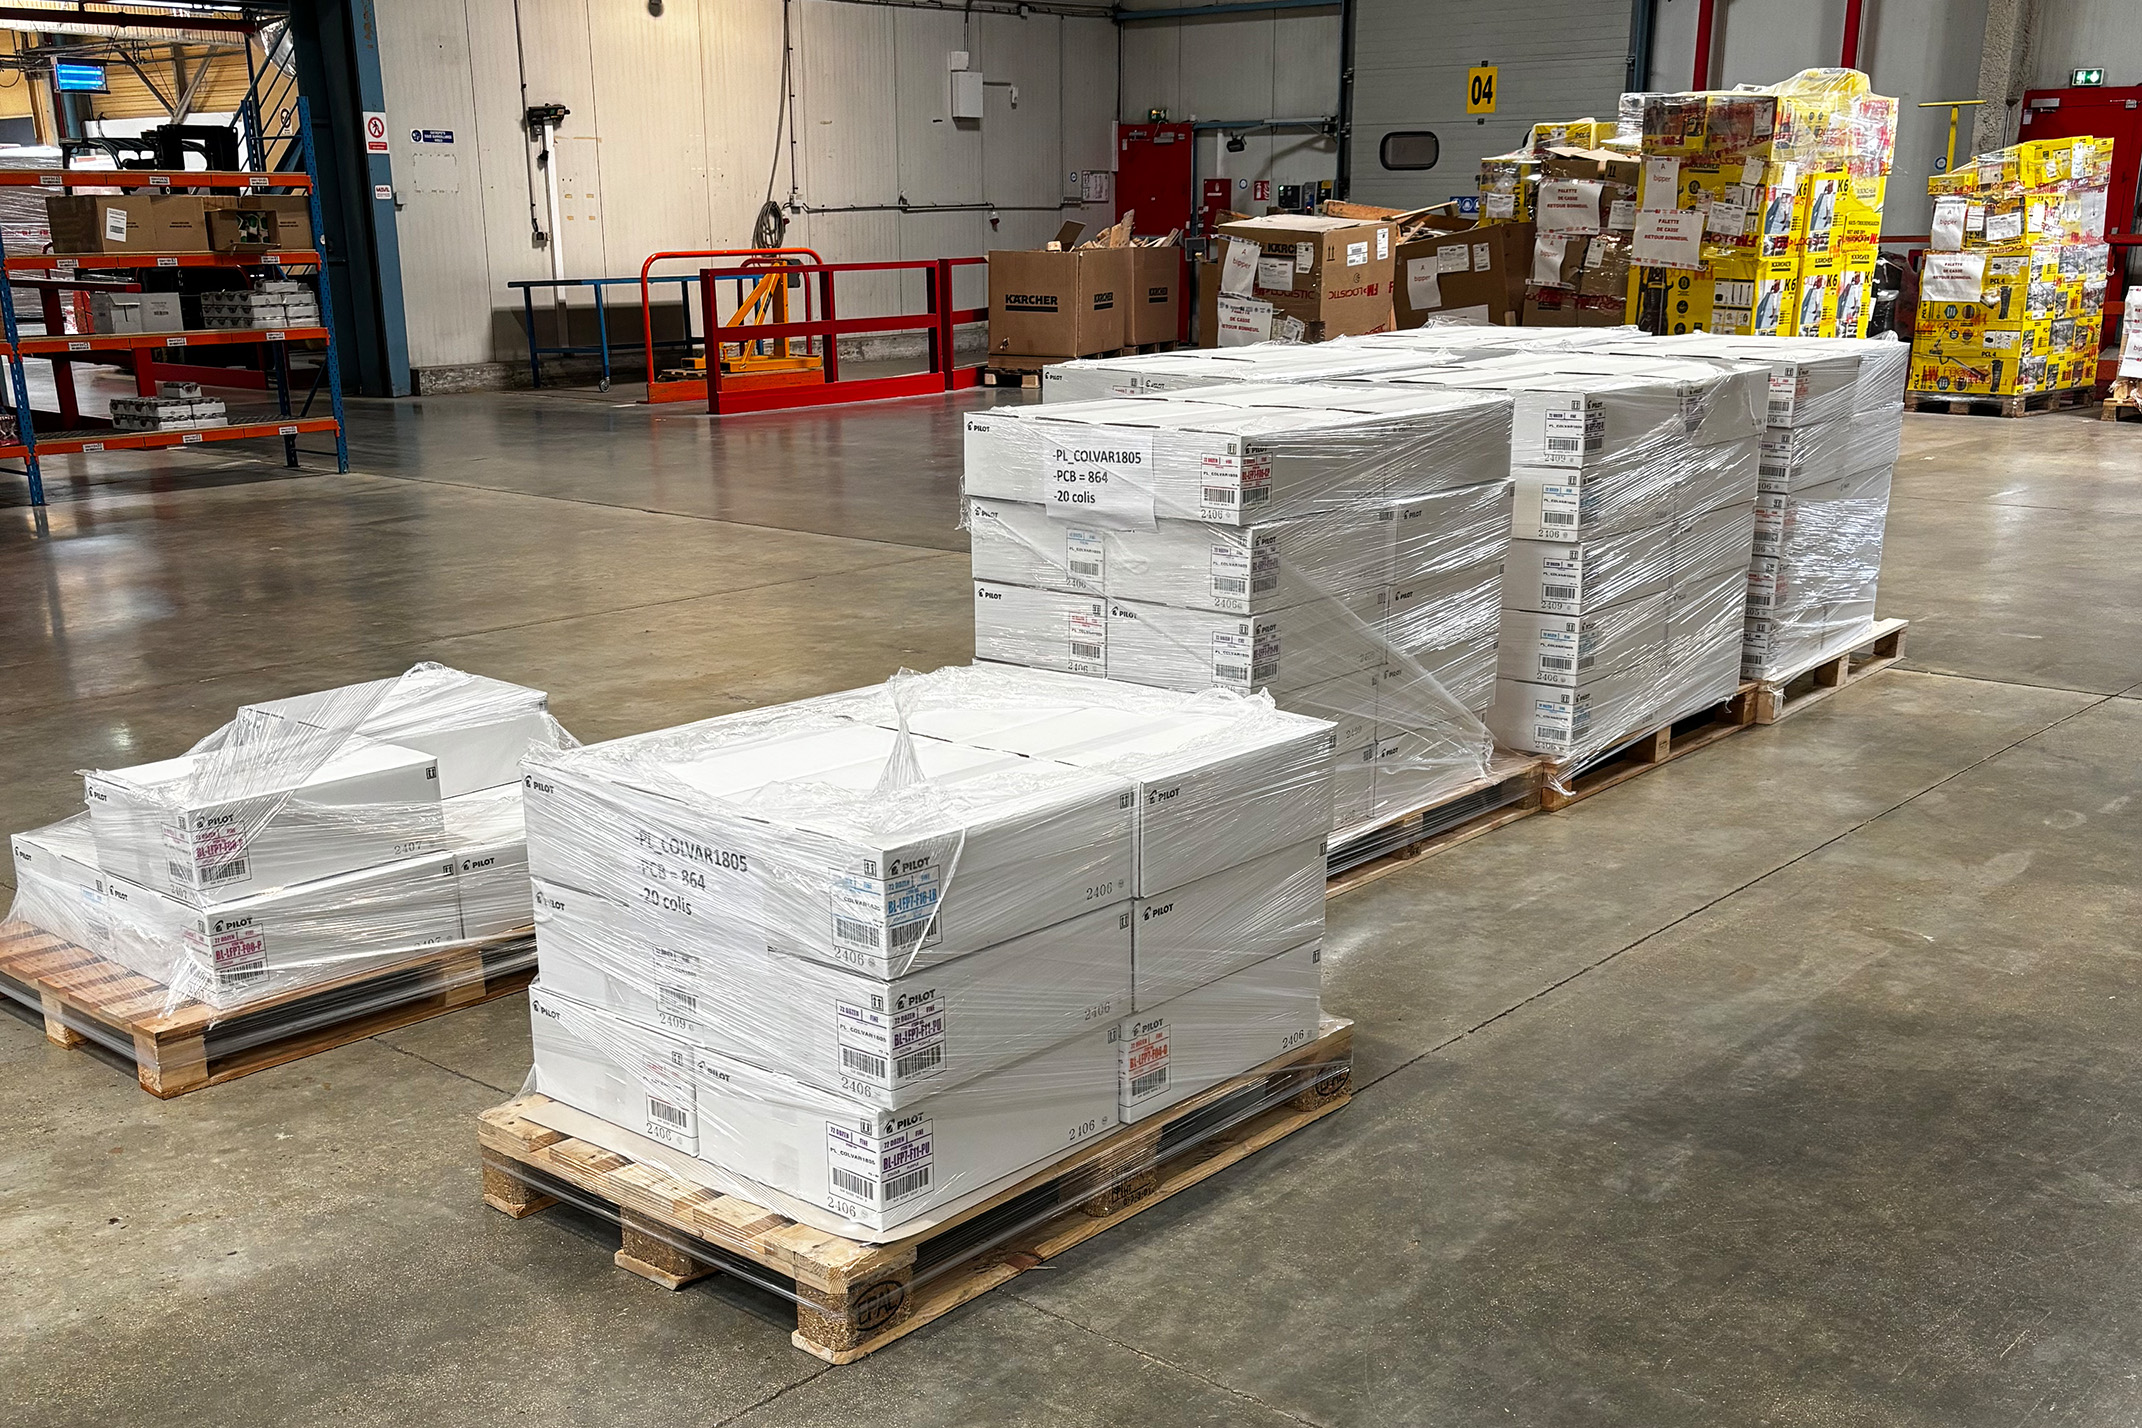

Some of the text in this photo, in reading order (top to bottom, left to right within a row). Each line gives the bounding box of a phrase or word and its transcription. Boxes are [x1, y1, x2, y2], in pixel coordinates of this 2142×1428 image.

[1471, 74, 1493, 106] 04
[1653, 174, 1672, 182] bipper
[1837, 178, 1849, 193] K6
[1267, 242, 1298, 254] KÄRC
[1784, 277, 1797, 292] K6
[1826, 273, 1838, 288] K6
[1591, 401, 1603, 409] PILOT
[973, 425, 990, 433] PILOT
[1052, 449, 1142, 465] -PL_COLVAR1805
[1053, 469, 1109, 484] -PCB = 864
[1053, 490, 1096, 504] -20 colis
[1201, 508, 1223, 520] 2406
[1408, 510, 1423, 519] PILOT
[1261, 536, 1277, 545] PILOT
[1538, 529, 1560, 539] 2406
[1066, 576, 1087, 589] 2406
[984, 592, 1002, 600] PILOT
[1400, 591, 1414, 600] PILOT
[1214, 598, 1238, 609] 2406
[1541, 601, 1563, 610] 2409
[1118, 610, 1138, 619] PILOT
[1261, 624, 1277, 634] PILOT
[1067, 661, 1089, 674] 2406
[1536, 672, 1558, 682] 2406
[1386, 747, 1399, 757] PILOT
[533, 781, 554, 794] PILOT
[94, 791, 107, 802] PILOT
[1158, 788, 1180, 802] PILOT
[208, 813, 234, 827] PILOT
[393, 841, 422, 856] 2407
[19, 851, 32, 862] PILOT
[472, 857, 496, 869] PILOT
[902, 856, 931, 873] PILOT
[681, 869, 707, 891] 864
[888, 883, 895, 891] 72
[114, 890, 128, 902] PILOT
[170, 883, 188, 900] 2407
[1086, 881, 1113, 901] 2406
[638, 887, 693, 916] -20 colis
[1152, 903, 1174, 919] PILOT
[226, 917, 254, 930] PILOT
[833, 945, 865, 967] 2406
[908, 988, 936, 1006] PILOT
[541, 1006, 561, 1020] PILOT
[846, 1007, 860, 1017] DOZEN
[901, 1012, 916, 1023] DOZEN
[926, 1004, 935, 1013] FINE
[1084, 1001, 1111, 1021] 2406
[659, 1012, 686, 1030] 2409
[1142, 1017, 1164, 1034] PILOT
[1282, 1029, 1305, 1050] 2406
[707, 1066, 731, 1082] PILOT
[841, 1076, 872, 1098] 2406
[896, 1112, 924, 1130] PILOT
[646, 1122, 672, 1141] 2406
[830, 1126, 868, 1147] 72 DOZEN FINE
[1068, 1119, 1096, 1142] 2406
[883, 1128, 924, 1149] 72 DOZEN FINE
[883, 1141, 930, 1171] BL-LFP7-F11-PU
[827, 1195, 857, 1218] 2406
